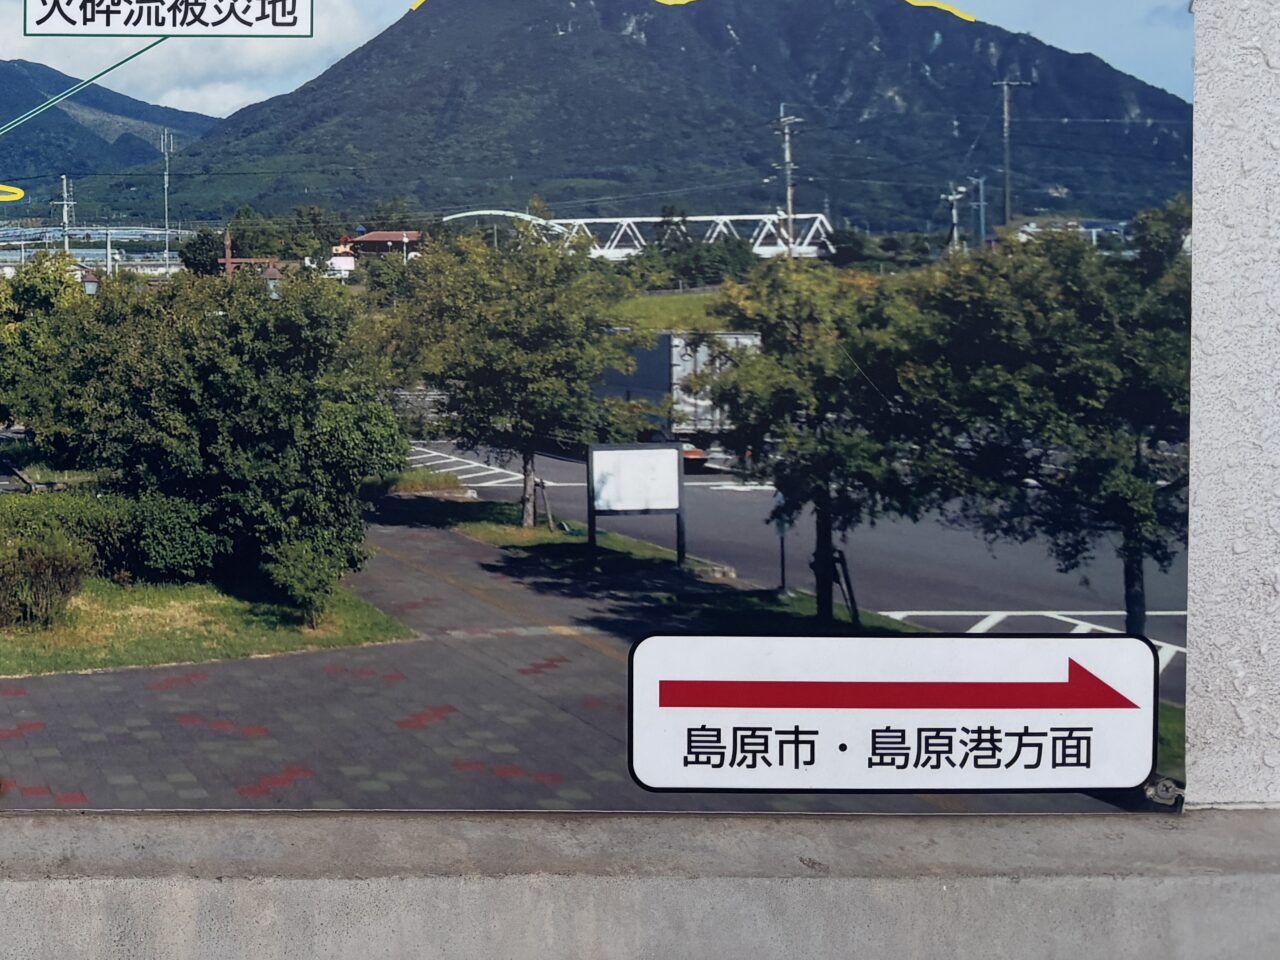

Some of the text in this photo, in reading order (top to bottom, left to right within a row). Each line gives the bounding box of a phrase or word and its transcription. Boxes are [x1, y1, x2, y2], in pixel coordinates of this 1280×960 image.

[683, 724, 1094, 770] 島原市・島原港方面
